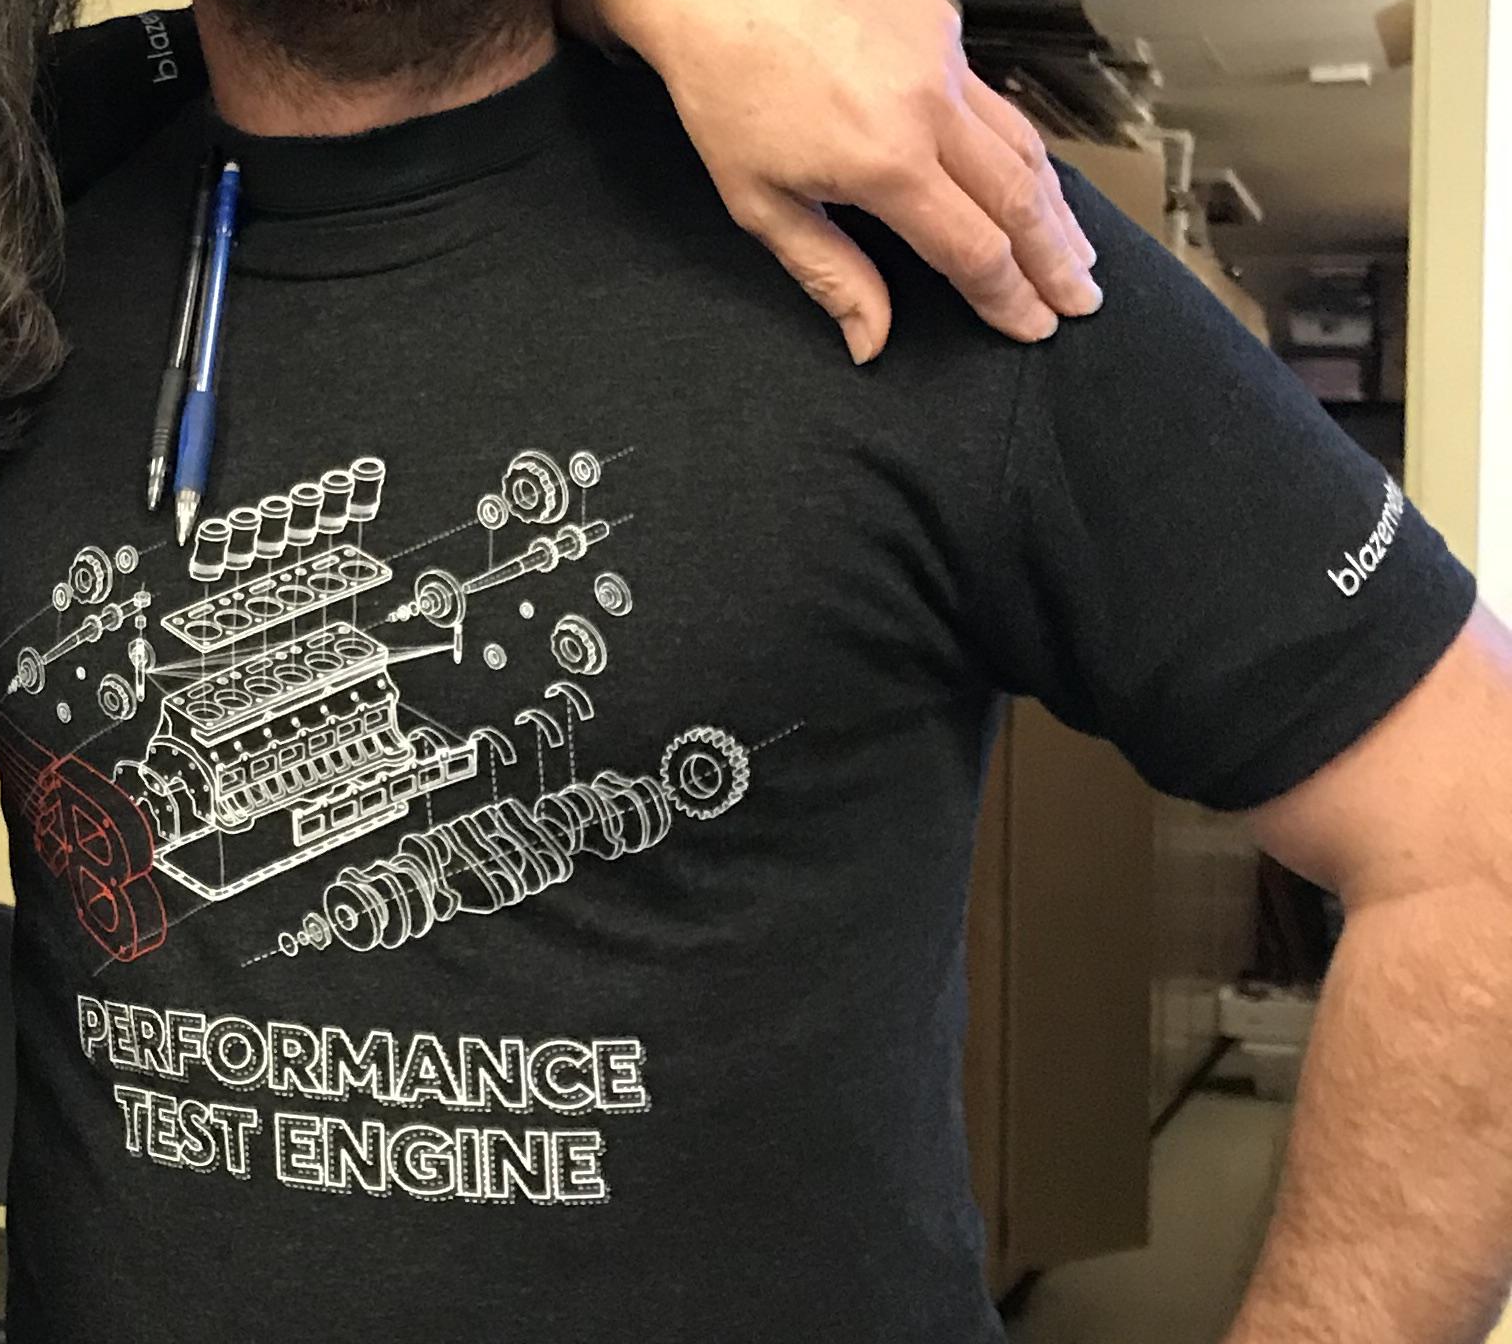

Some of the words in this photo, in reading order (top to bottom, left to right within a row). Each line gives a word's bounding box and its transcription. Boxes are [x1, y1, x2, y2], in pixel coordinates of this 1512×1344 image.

[77, 994, 652, 1116] PERFORMANCE
[114, 1084, 264, 1180] TEST
[274, 1111, 611, 1206] ENGINE
